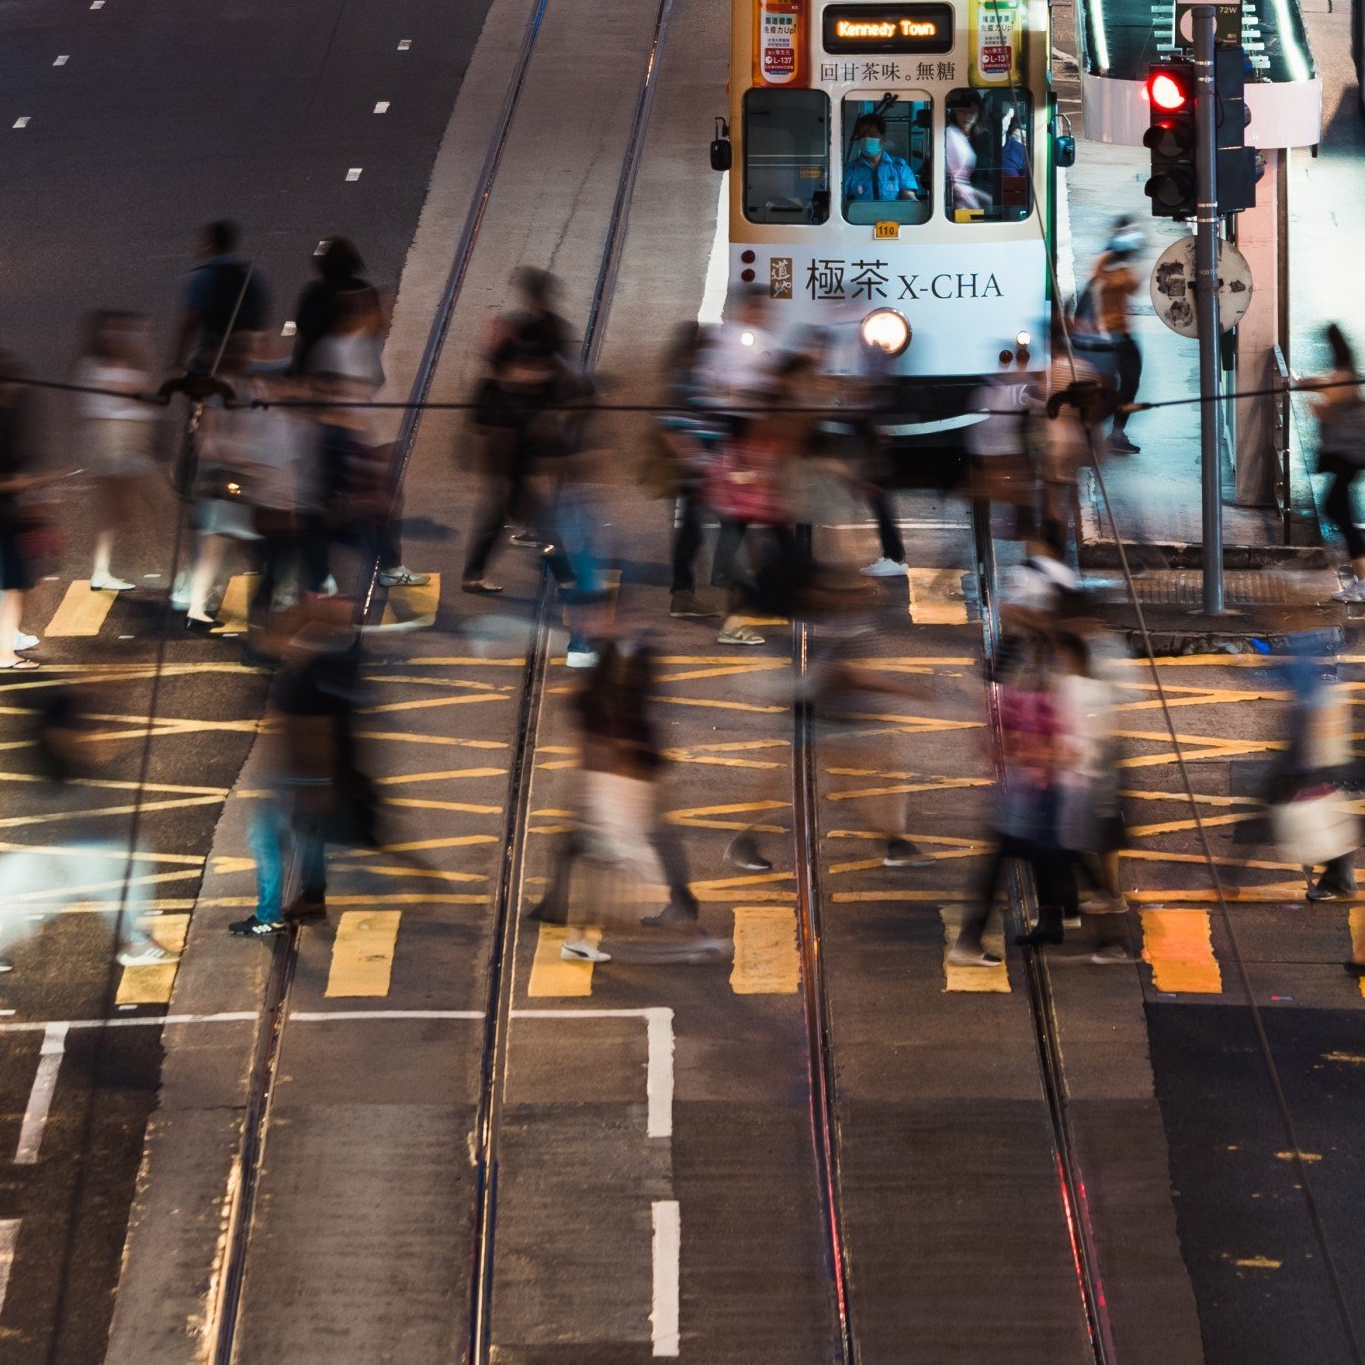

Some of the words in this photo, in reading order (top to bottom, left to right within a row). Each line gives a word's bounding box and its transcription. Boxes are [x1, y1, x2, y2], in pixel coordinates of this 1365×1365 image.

[1219, 6, 1237, 14] 72W
[838, 20, 896, 38] Kennedy
[899, 20, 935, 36] Town
[773, 56, 792, 64] L-137
[820, 62, 956, 82] 回甘茶味。無糖
[878, 224, 895, 236] 110
[805, 259, 889, 300] 極茶
[897, 272, 1004, 300] X-CHA
